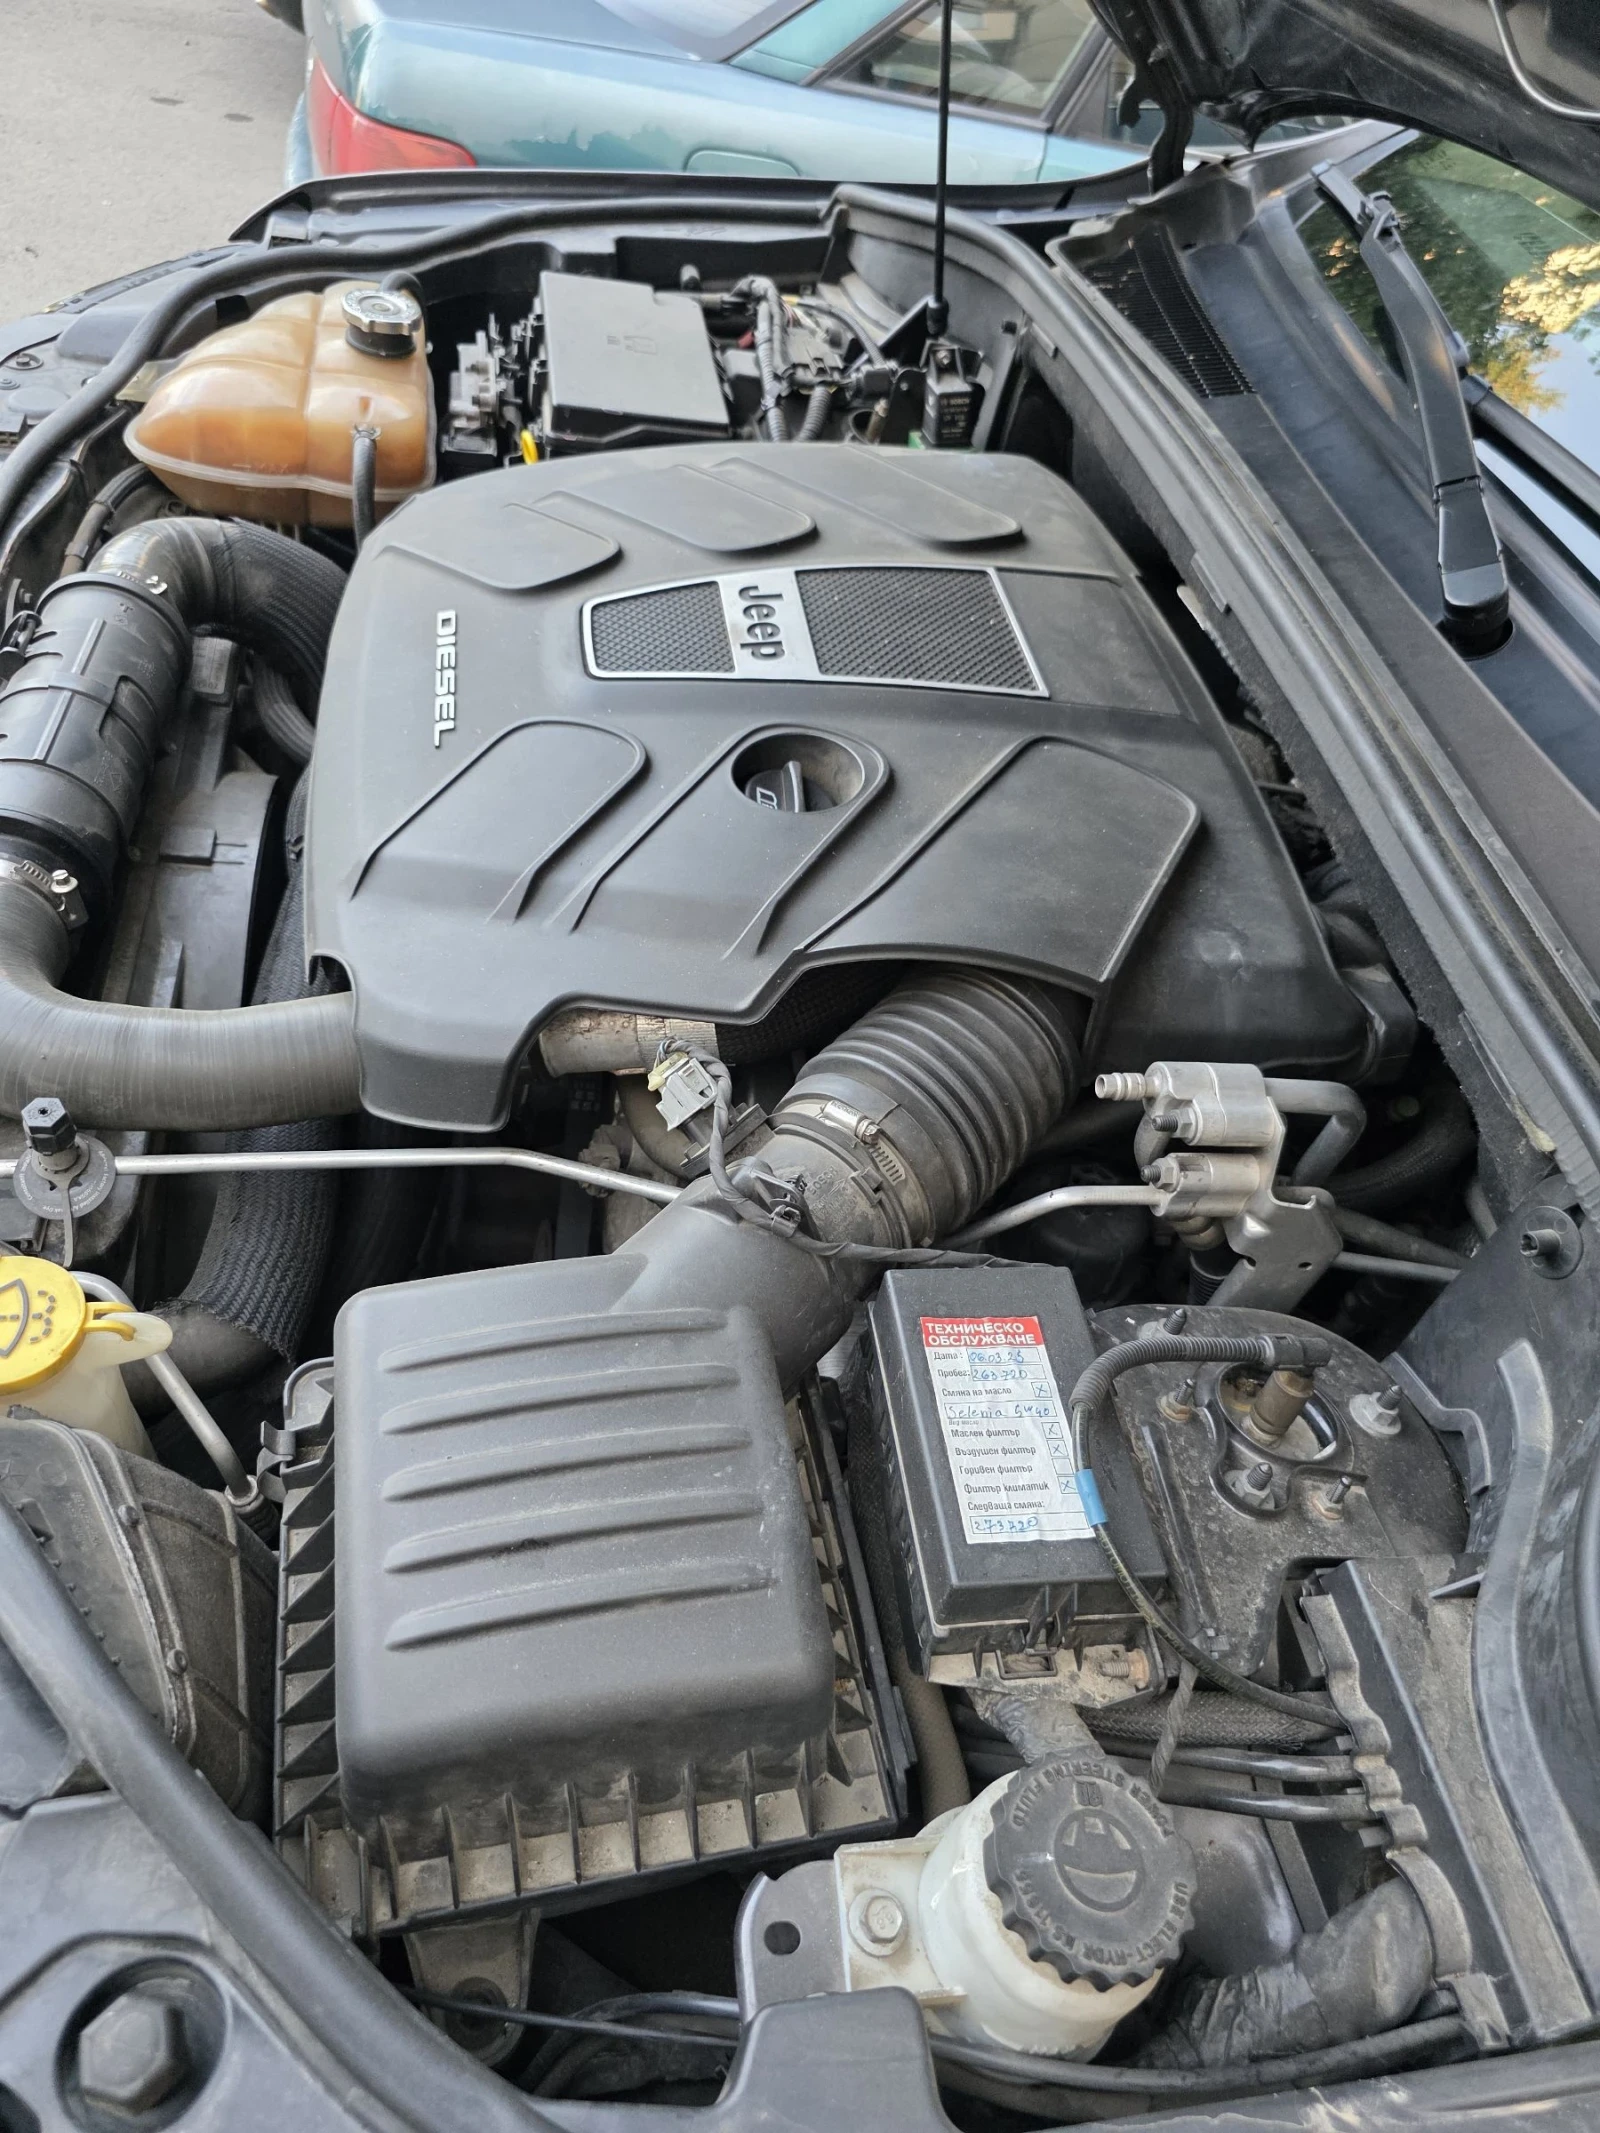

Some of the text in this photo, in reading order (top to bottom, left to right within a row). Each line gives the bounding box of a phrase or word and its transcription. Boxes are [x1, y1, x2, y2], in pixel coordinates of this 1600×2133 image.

[738, 585, 786, 661] Jeep
[433, 609, 457, 749] DIESEL
[925, 1322, 1025, 1334] ТЕХНИЧЕСКО
[928, 1333, 1036, 1346] ОБСЛУЖВАНЕ
[942, 1387, 1012, 1397] Смяна на масло
[951, 1428, 1021, 1438] Маслен филтър
[955, 1446, 1036, 1457] Въздушен филтър
[959, 1464, 1033, 1476] Горивен филтър
[963, 1483, 1002, 1494] Филтър
[967, 1501, 1012, 1512] Следваща
[1012, 1760, 1175, 1838] POWER STEERING FLUID
[1169, 1881, 1188, 1920] USE
